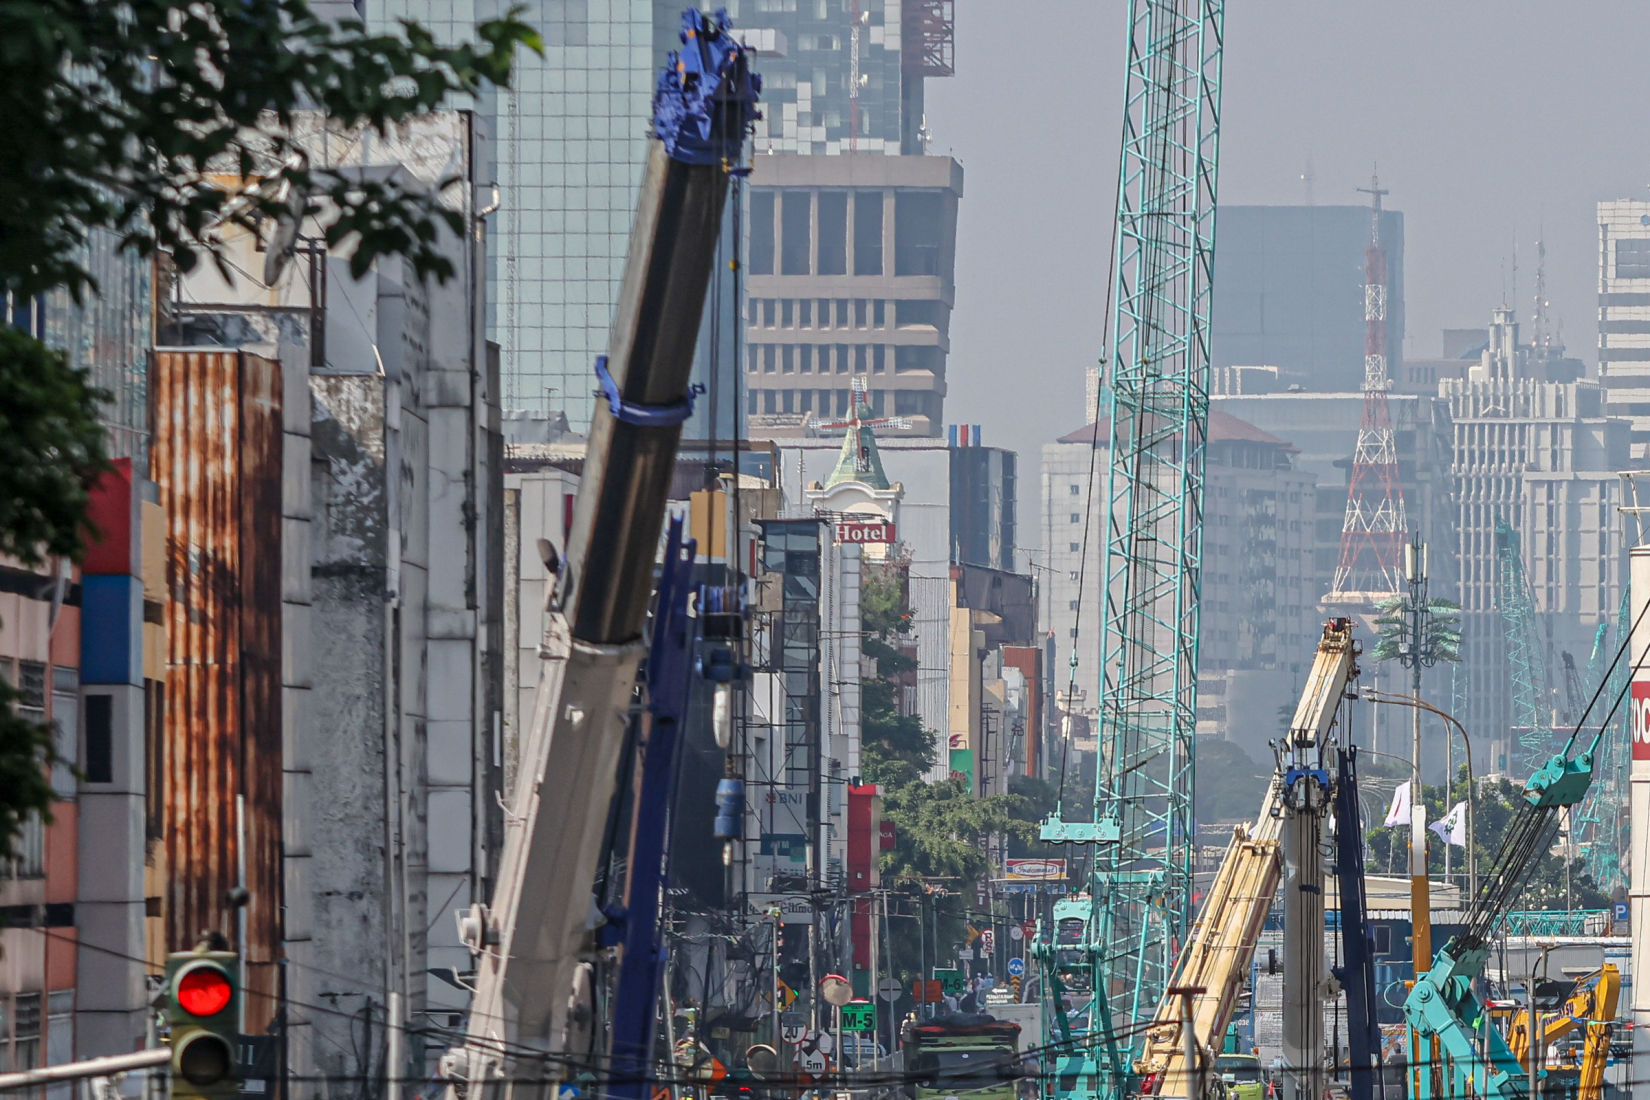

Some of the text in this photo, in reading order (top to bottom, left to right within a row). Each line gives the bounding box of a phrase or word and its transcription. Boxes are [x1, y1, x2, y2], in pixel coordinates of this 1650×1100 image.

[835, 525, 887, 540] Hotel
[1615, 904, 1627, 919] P
[843, 1013, 873, 1028] M-5
